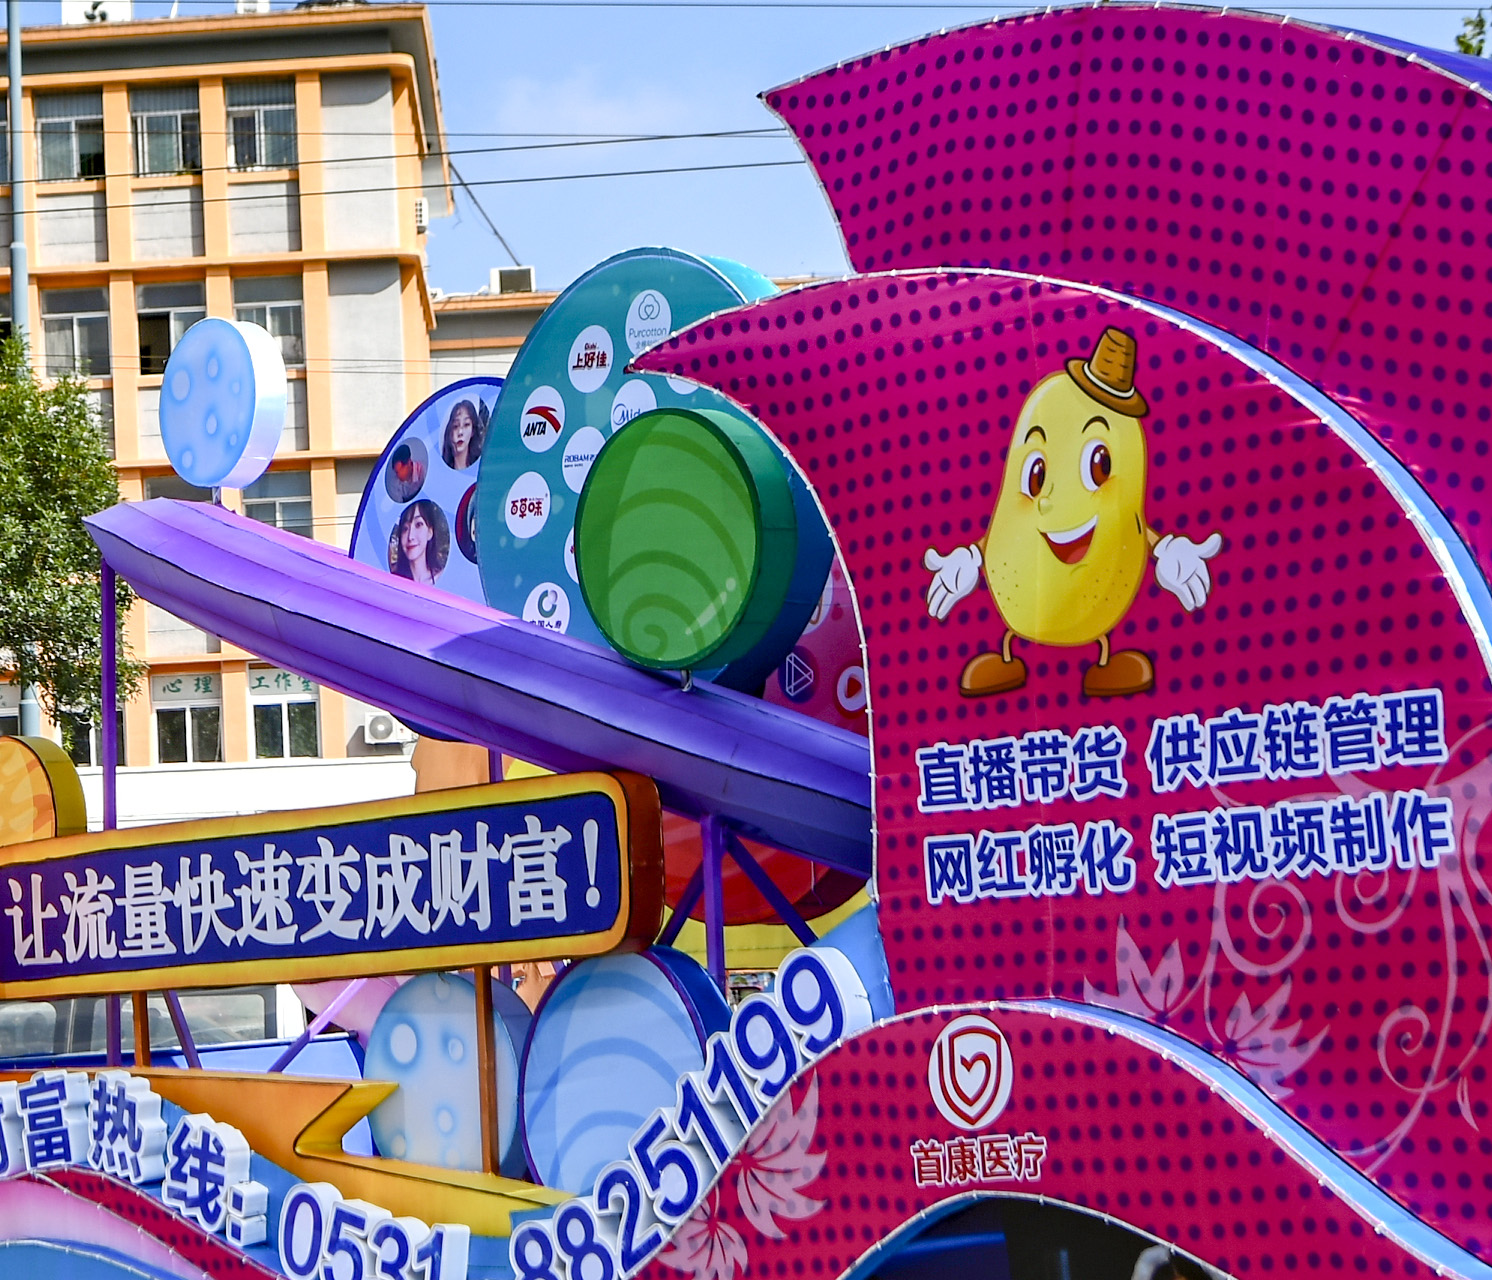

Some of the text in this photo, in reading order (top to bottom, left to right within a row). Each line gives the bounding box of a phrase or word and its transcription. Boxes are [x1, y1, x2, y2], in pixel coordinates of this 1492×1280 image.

[629, 327, 667, 339] Purcotton
[572, 351, 608, 369] 上好佳
[523, 421, 547, 437] ANTA
[564, 454, 589, 463] ROBAM
[511, 498, 543, 519] 百草味
[162, 672, 313, 694] 心理 工作室
[918, 692, 1445, 809] 直播带货 供应链管理
[927, 792, 1452, 901] 网红孵化 短视频制作
[4, 814, 601, 966] 让流量快速变成财富！
[912, 1133, 1047, 1185] 首康医疗
